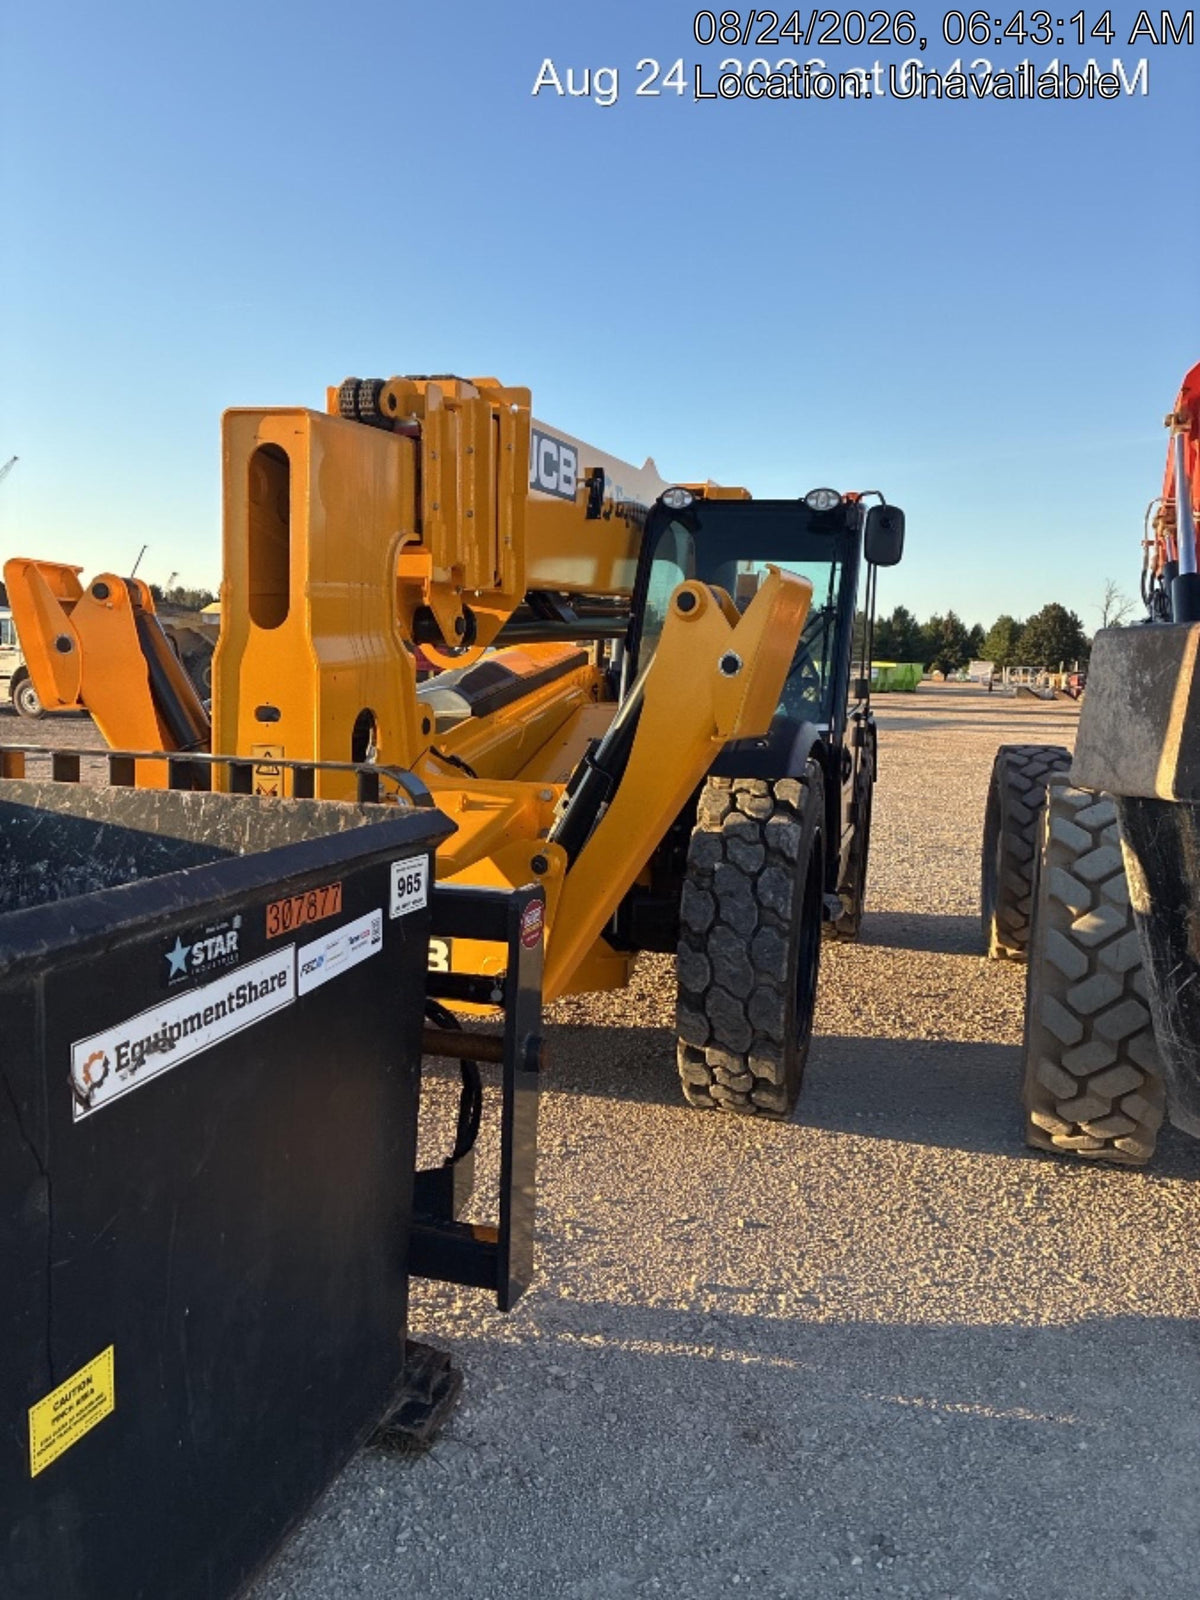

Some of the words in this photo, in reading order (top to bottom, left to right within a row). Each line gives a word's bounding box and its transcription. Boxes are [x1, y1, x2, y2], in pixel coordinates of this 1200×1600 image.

[530, 435, 577, 496] JCB
[269, 883, 340, 935] 307877
[397, 872, 421, 898] 965
[191, 931, 239, 966] STAR
[114, 970, 287, 1073] EquipmentShare
